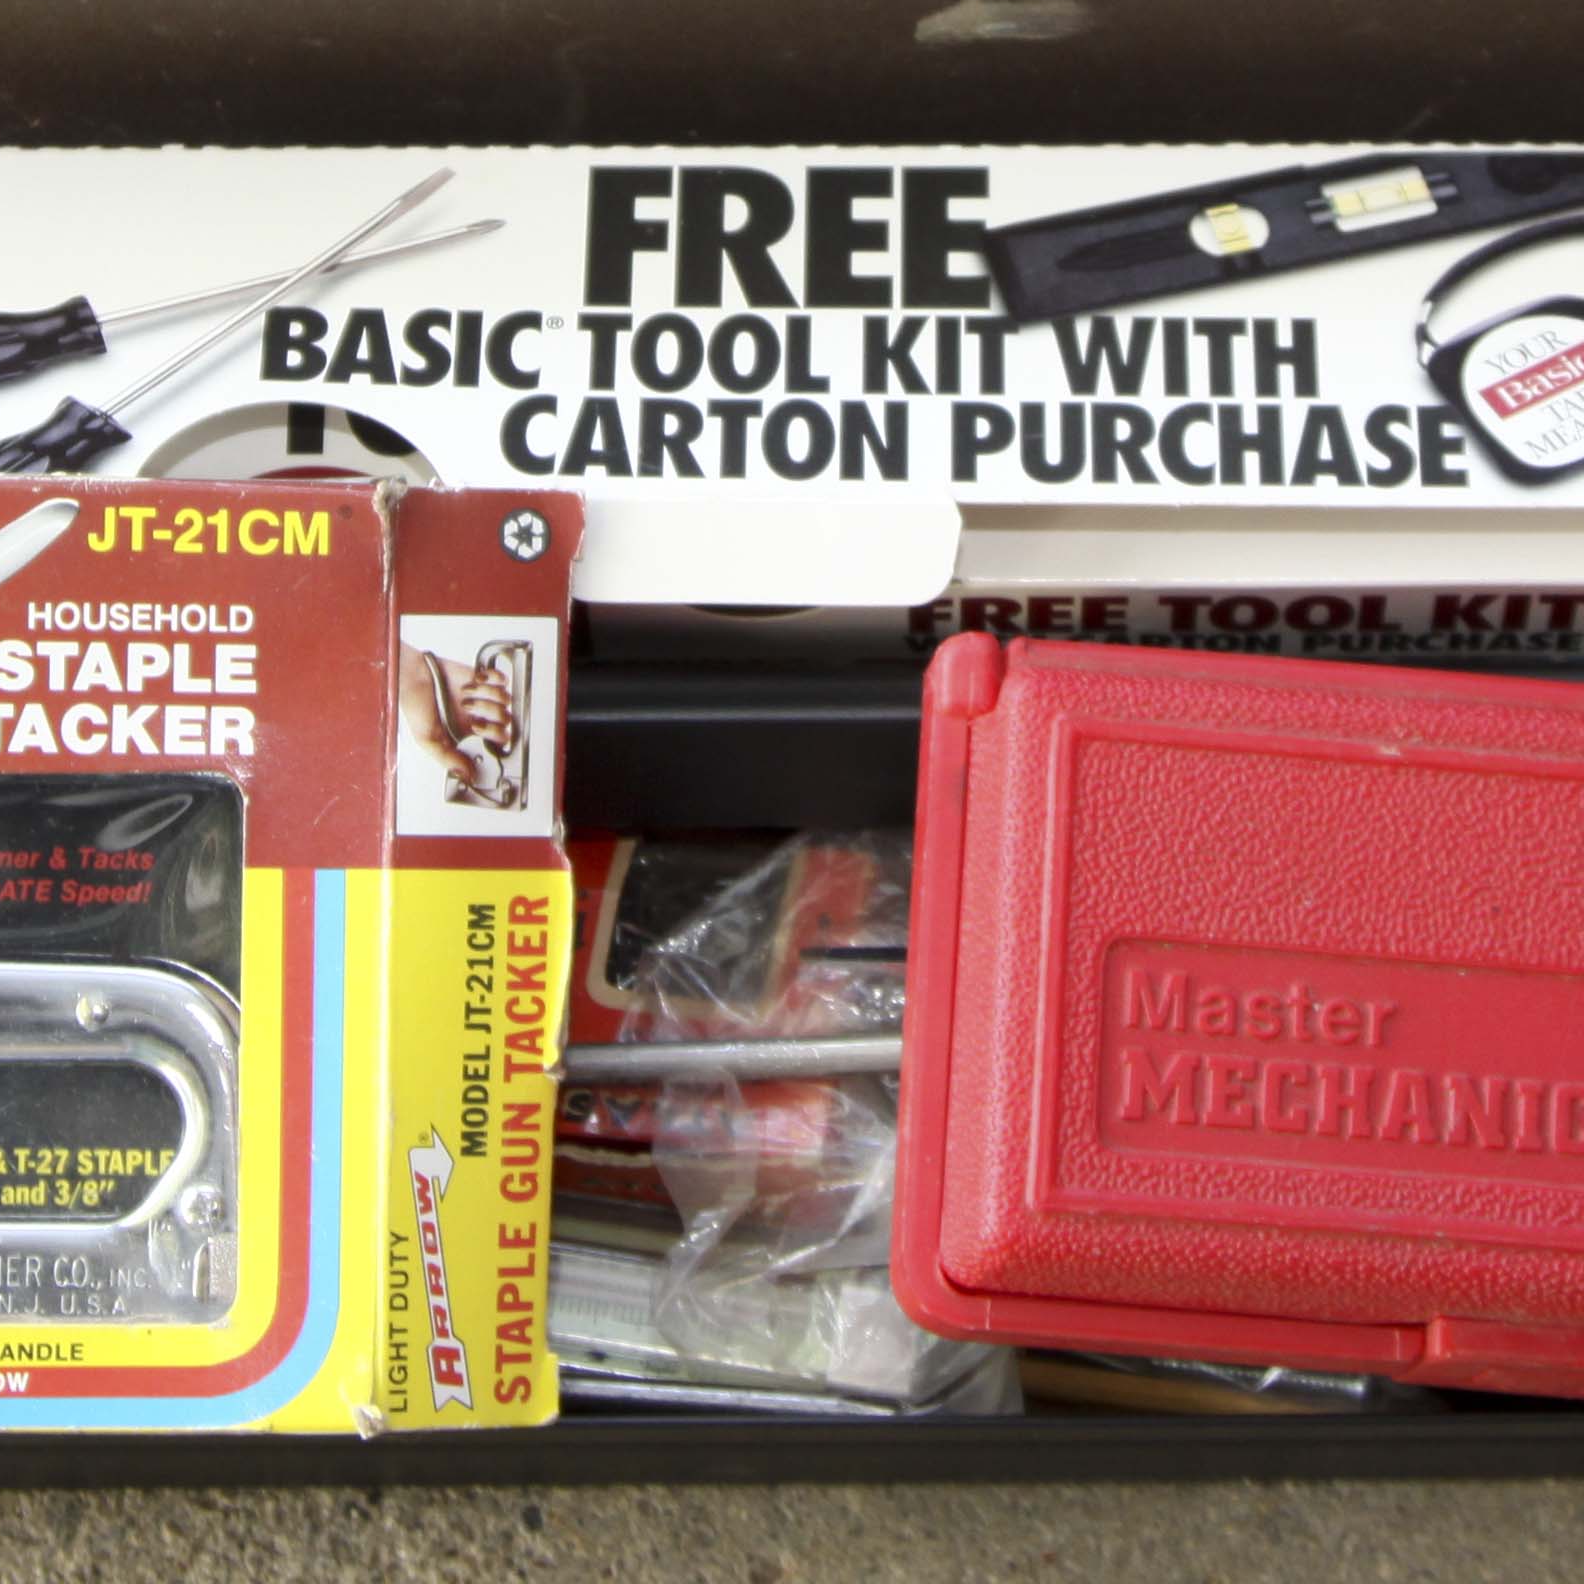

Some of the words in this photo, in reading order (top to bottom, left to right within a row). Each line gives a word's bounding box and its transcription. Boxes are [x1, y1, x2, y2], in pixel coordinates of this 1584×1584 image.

[583, 165, 992, 309] FREE
[260, 307, 543, 389] BASIC
[577, 312, 830, 395] TOOL
[862, 315, 1016, 396] KIT
[1051, 316, 1319, 398] WITH
[1483, 324, 1568, 380] YOUR
[500, 395, 910, 480] CARTON
[951, 401, 1470, 488] PURCHASE
[86, 507, 332, 555] JT-21CM
[27, 601, 254, 634] HOUSEHOLD
[907, 594, 1130, 633] FREE
[1158, 594, 1405, 632] TOOL
[49, 845, 67, 870] &
[78, 847, 156, 870] Tacks
[61, 879, 153, 907] Speed!
[464, 903, 496, 1038] JT-21CM
[503, 894, 550, 1088] TACKER
[1123, 968, 1395, 1049] Master
[460, 1046, 490, 1157] MODEL
[1, 1180, 46, 1206] and
[54, 1179, 116, 1209] 3/8"
[14, 1148, 69, 1174] T-27
[499, 1102, 540, 1204] GUN
[110, 1267, 153, 1289] INC.
[388, 1229, 410, 1312] DUTY
[415, 1171, 465, 1388] ARROW
[494, 1222, 537, 1405] STAPLE
[388, 1318, 409, 1415] LIGHT
